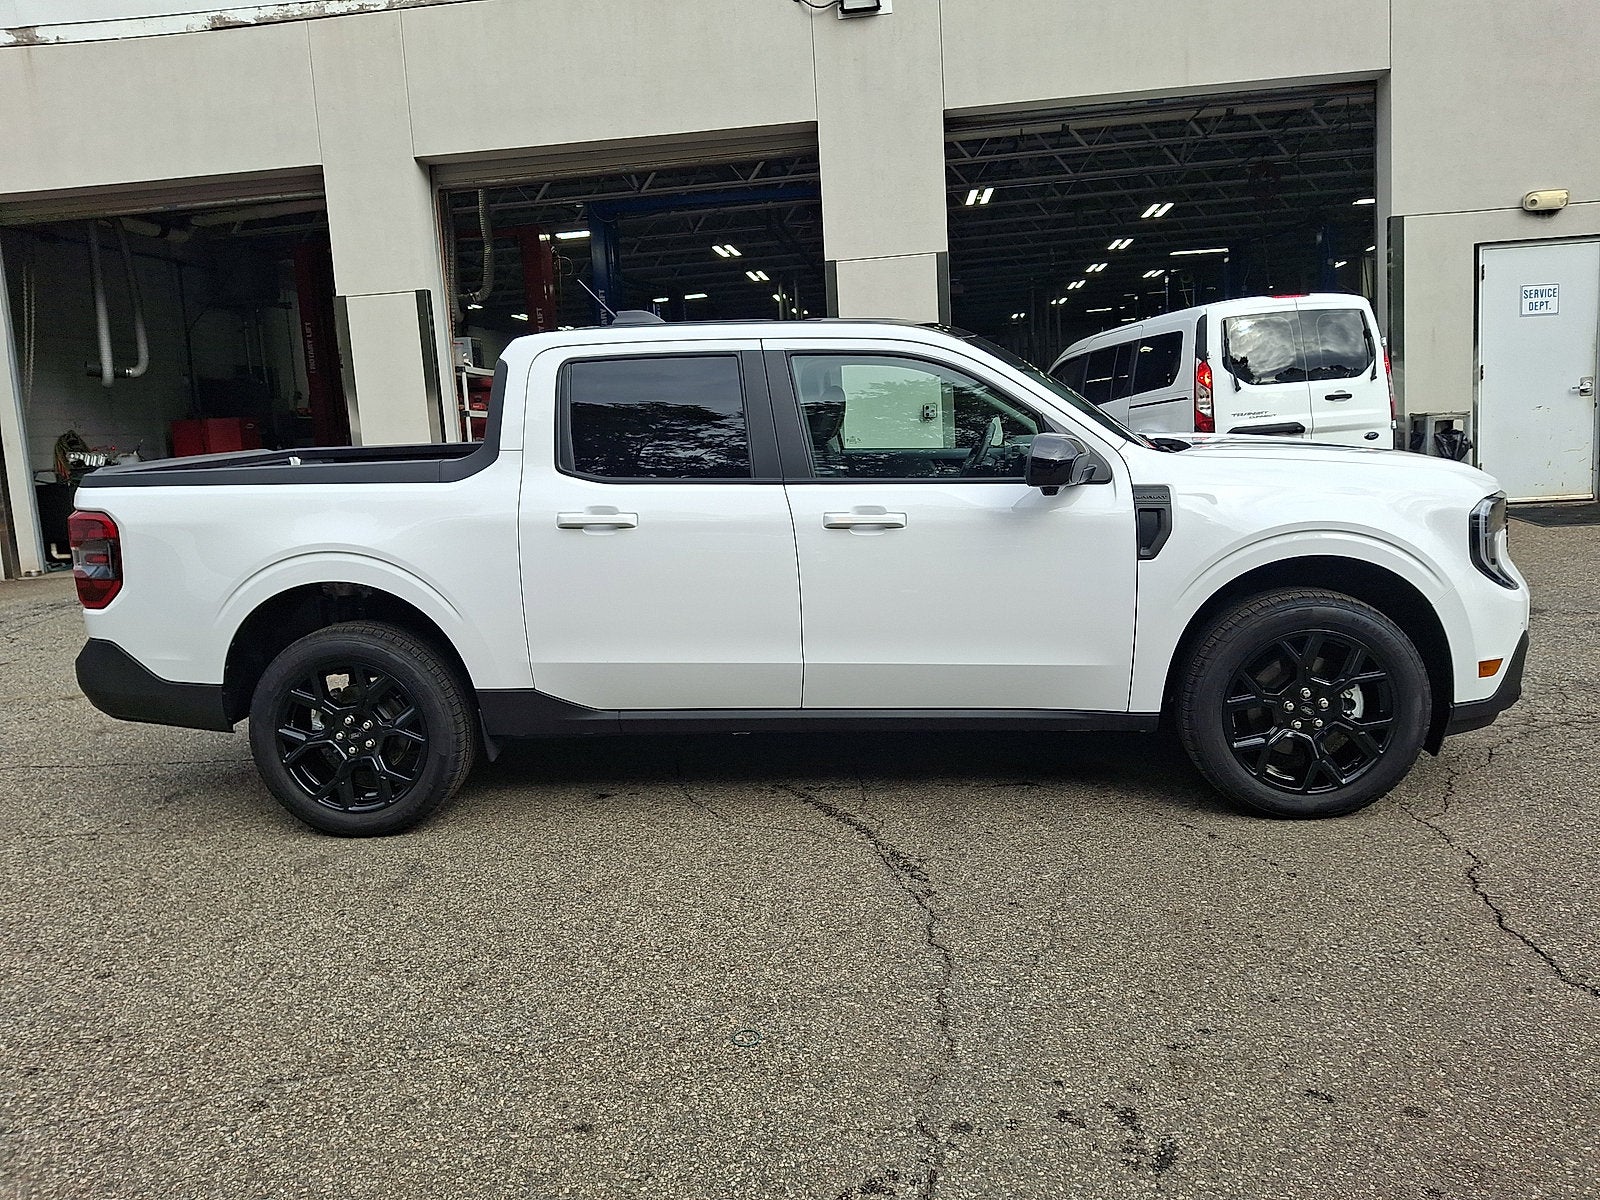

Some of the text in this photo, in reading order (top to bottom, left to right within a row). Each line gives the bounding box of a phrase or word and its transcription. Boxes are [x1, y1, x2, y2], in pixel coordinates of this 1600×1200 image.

[1523, 287, 1557, 299] SERVICE
[1528, 300, 1552, 311] DEPT.
[536, 307, 544, 324] LIFT
[304, 321, 312, 338] LIFT
